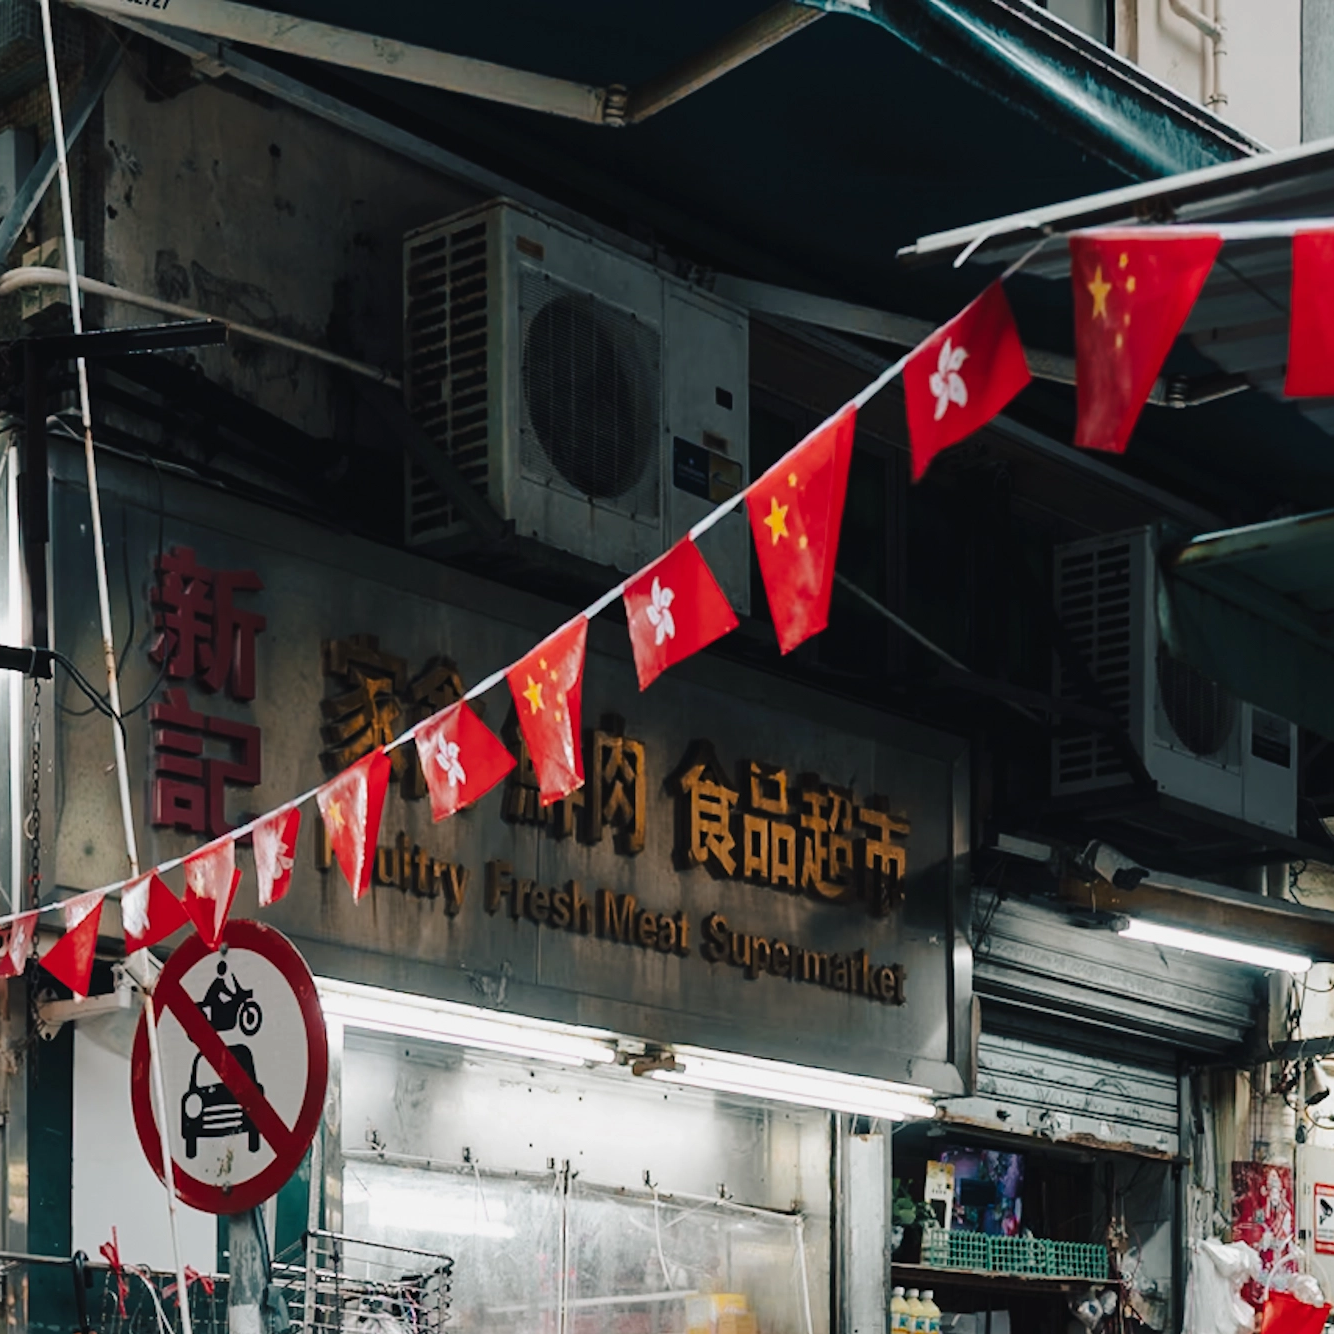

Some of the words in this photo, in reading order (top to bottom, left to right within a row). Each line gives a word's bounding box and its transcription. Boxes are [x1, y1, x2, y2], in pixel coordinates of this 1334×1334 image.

[147, 545, 266, 838] 新記
[484, 860, 594, 937] Fresh
[595, 888, 691, 957] Meat
[700, 911, 908, 1007] Supermarket
